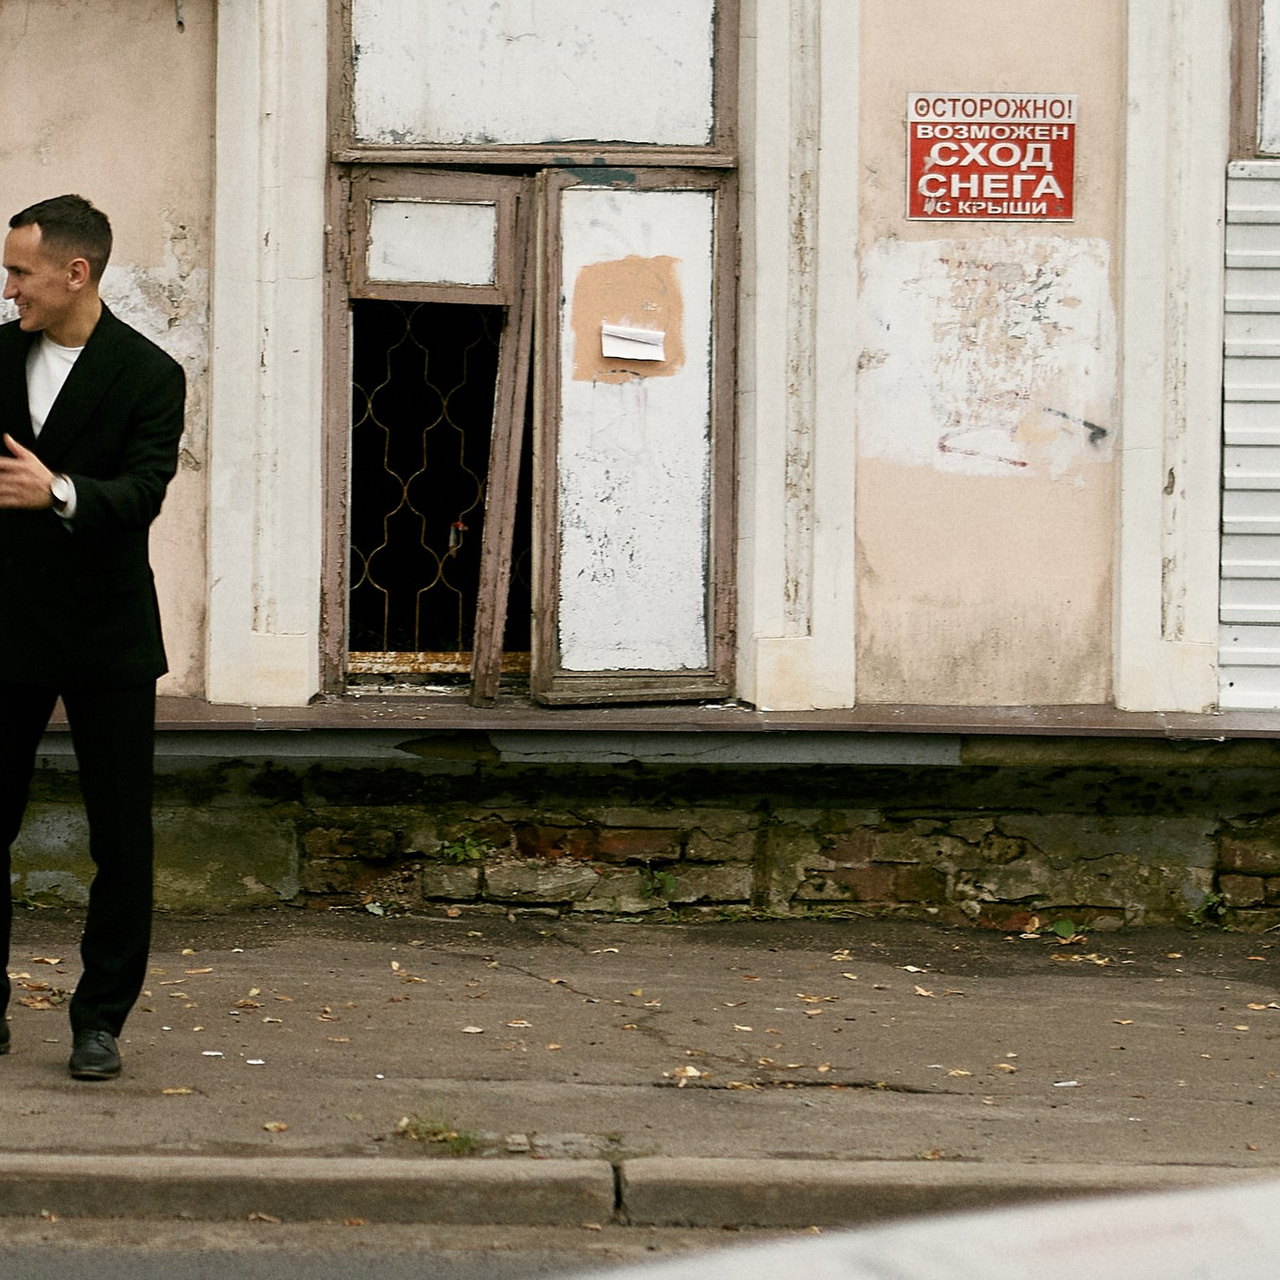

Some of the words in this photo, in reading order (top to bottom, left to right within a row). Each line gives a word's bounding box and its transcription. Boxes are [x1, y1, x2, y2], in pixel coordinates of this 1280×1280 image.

[914, 97, 1073, 119] ОСТОРОЖНО!
[916, 124, 1069, 140] ВОЗМОЖЕН
[929, 141, 1054, 171] СХОД
[918, 173, 1065, 199] СНЕГА
[935, 201, 951, 214] С
[958, 201, 1048, 215] КРЫШИ
